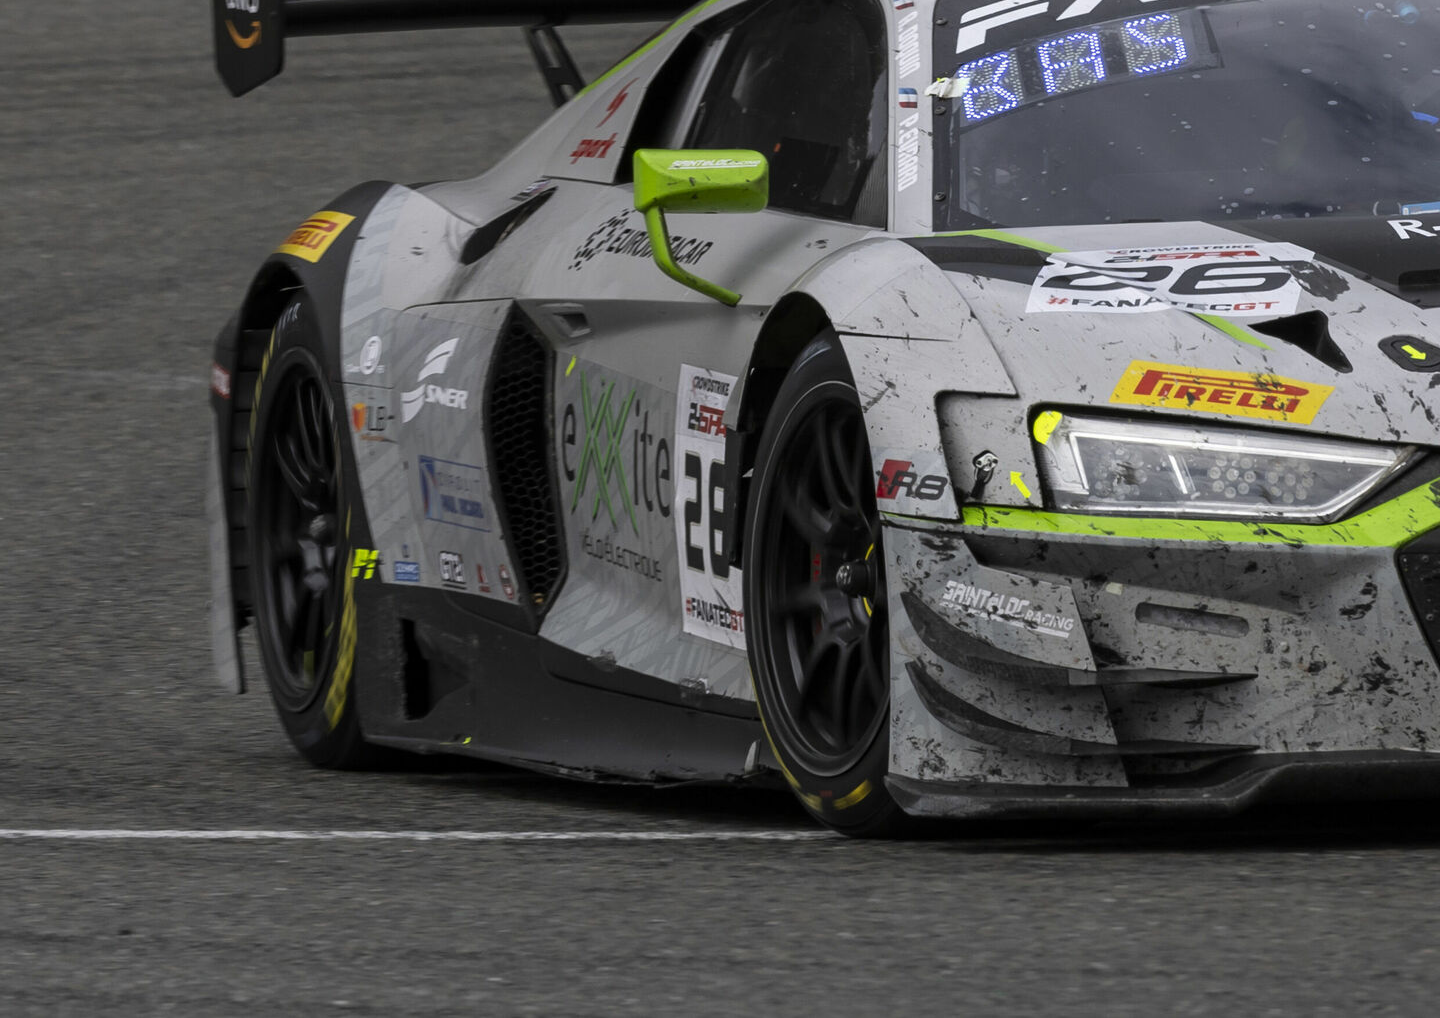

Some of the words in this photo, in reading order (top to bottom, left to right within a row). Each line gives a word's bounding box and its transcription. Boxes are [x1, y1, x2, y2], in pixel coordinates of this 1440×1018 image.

[1040, 259, 1312, 296] 26
[1132, 368, 1311, 414] PIRELLI
[887, 469, 949, 501] R8
[1024, 609, 1075, 632] RACING
